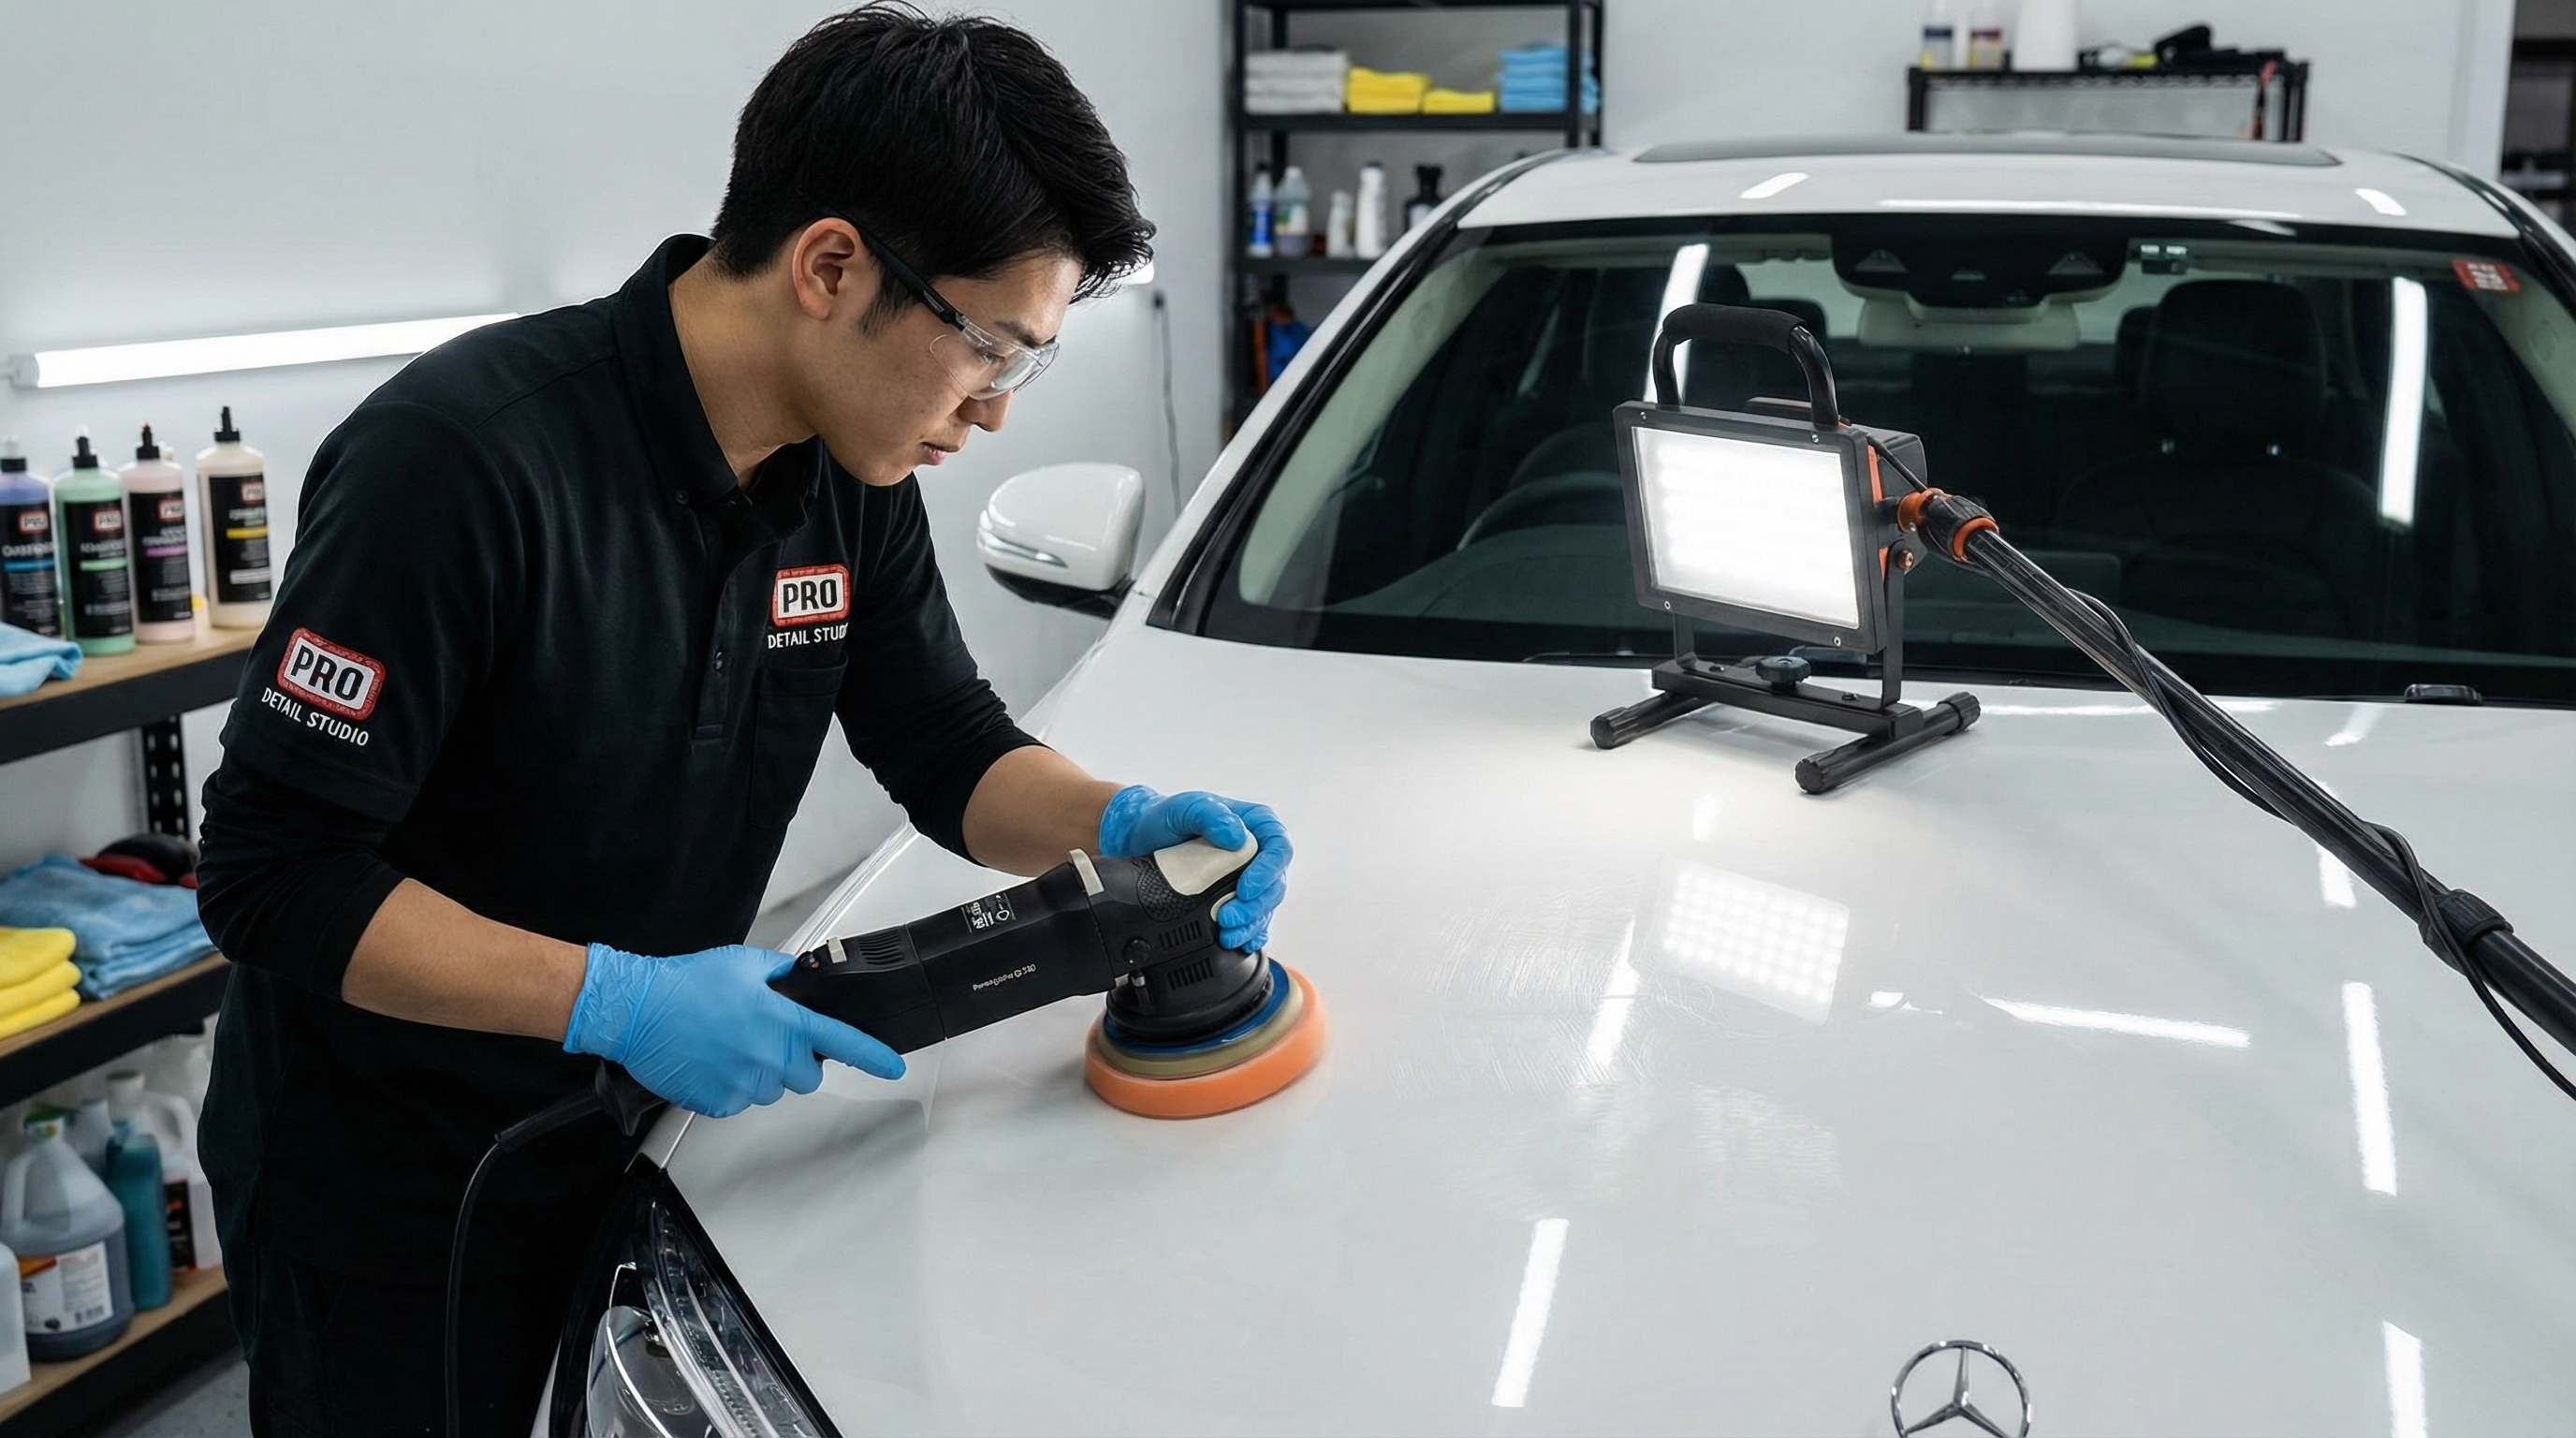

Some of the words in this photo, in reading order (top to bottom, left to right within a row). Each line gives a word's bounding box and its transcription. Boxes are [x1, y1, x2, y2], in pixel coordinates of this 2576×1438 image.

[783, 579, 837, 613] PRO
[768, 630, 811, 649] DETAIL
[813, 623, 849, 643] STUD
[290, 645, 364, 701] PRO
[261, 687, 301, 722] DETAIL
[306, 712, 369, 746] STUDIO
